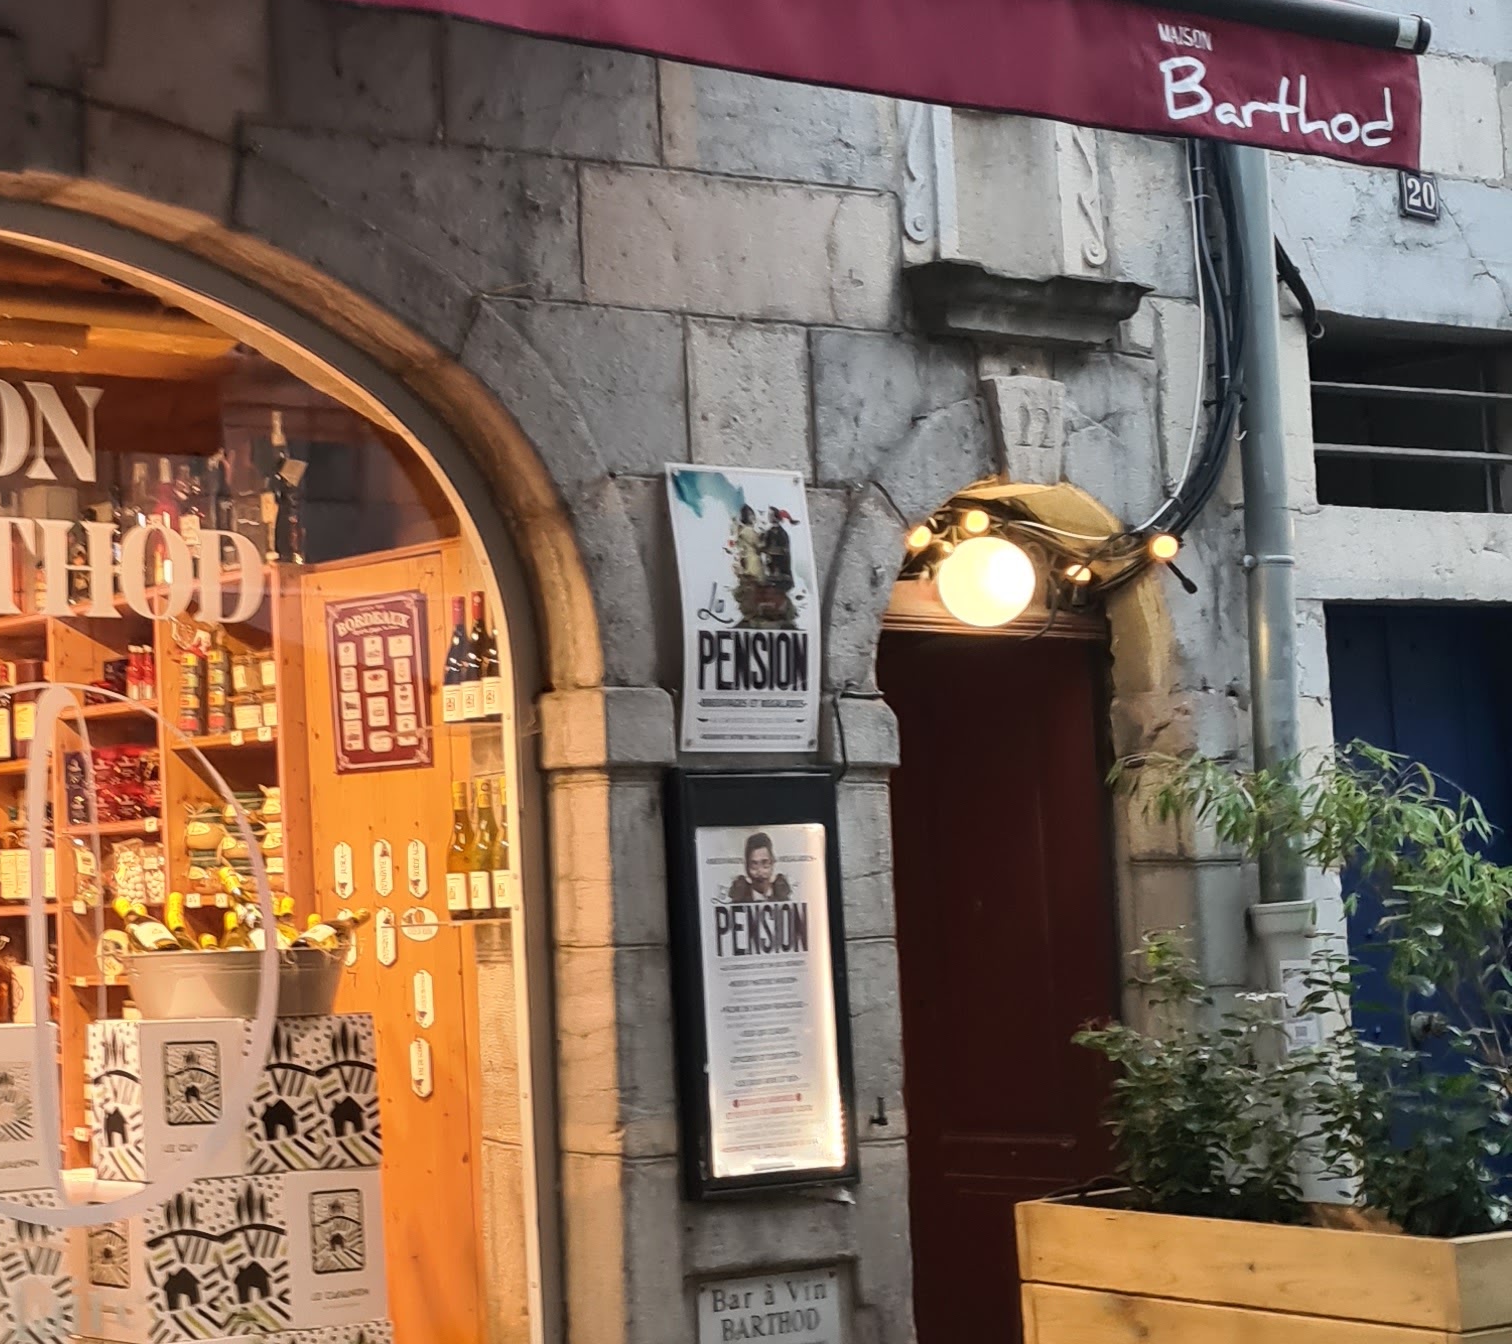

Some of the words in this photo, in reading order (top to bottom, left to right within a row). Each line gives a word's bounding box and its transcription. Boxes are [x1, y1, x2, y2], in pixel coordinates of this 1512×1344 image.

[1158, 23, 1212, 51] MAISON
[1159, 56, 1394, 147] Barthod
[1406, 177, 1436, 209] 20
[697, 630, 809, 692] PENSION
[714, 902, 809, 957] PENSION
[711, 1288, 753, 1313] Bar
[764, 1284, 776, 1306] à
[786, 1280, 828, 1304] Vin
[720, 1307, 821, 1342] BARTHOD
